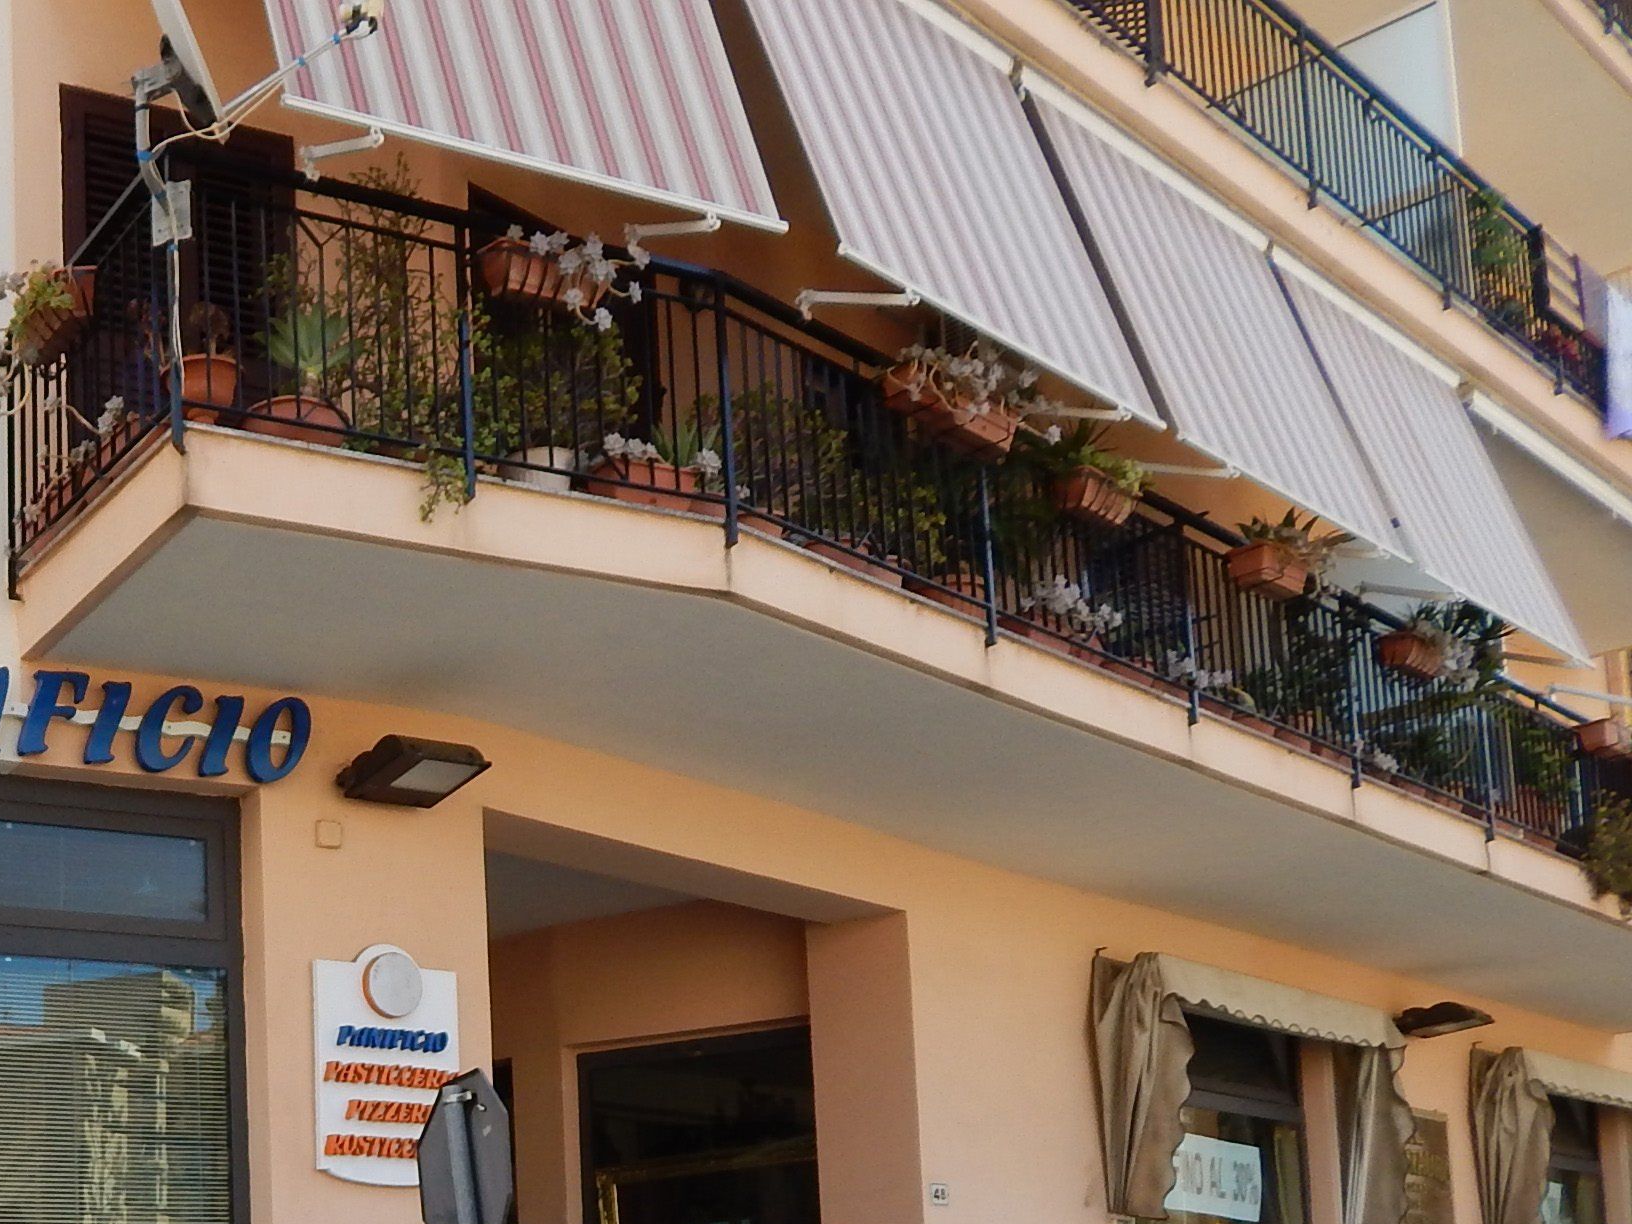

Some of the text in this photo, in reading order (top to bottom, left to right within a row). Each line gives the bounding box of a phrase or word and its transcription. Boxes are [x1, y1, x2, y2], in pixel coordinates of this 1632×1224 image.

[336, 1025, 448, 1053] PANIFICIO
[345, 1100, 434, 1124] PIZZERI
[324, 1134, 418, 1159] ROSTICC
